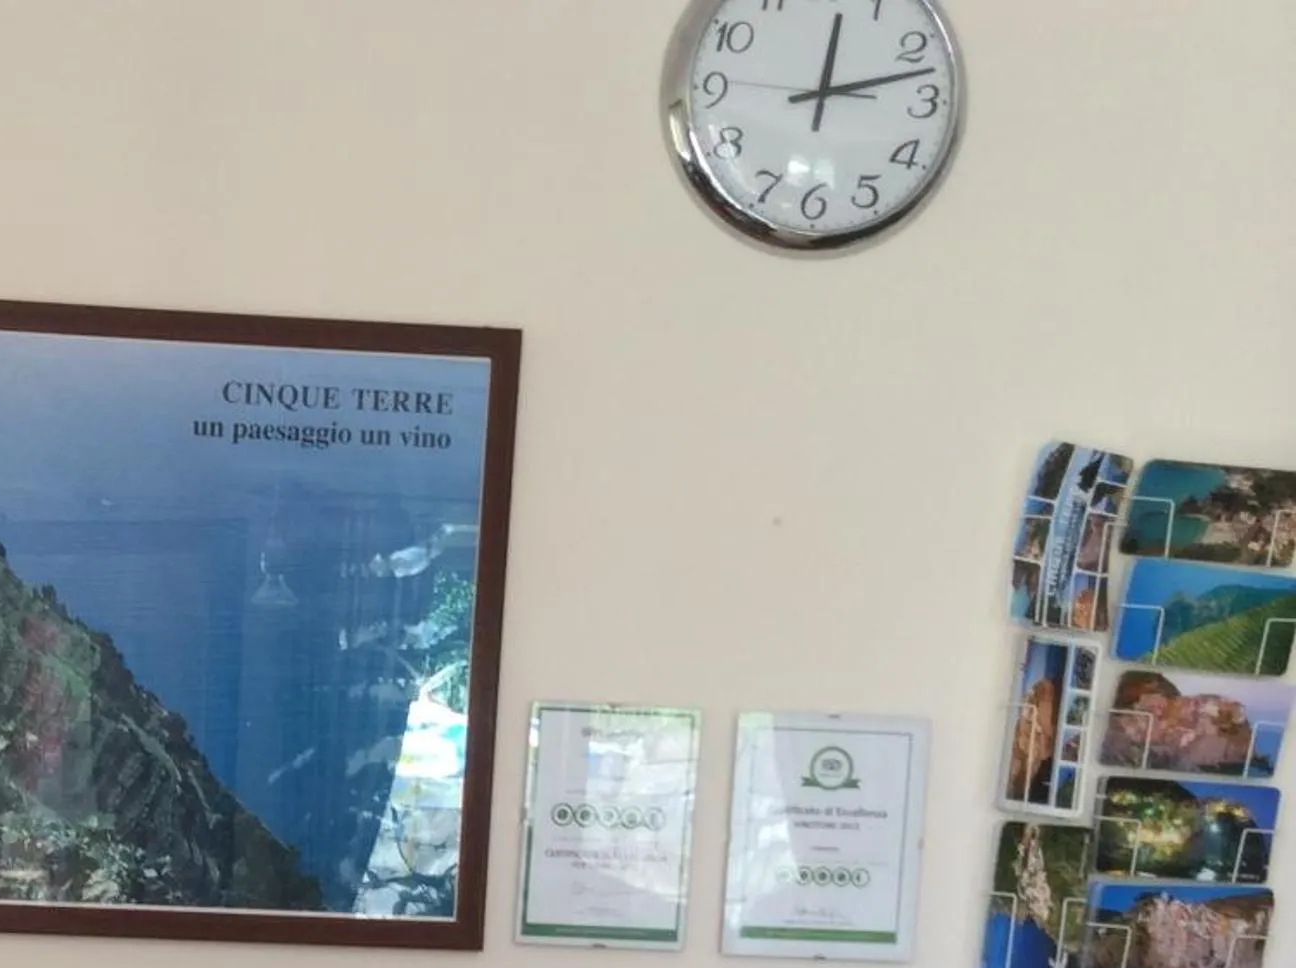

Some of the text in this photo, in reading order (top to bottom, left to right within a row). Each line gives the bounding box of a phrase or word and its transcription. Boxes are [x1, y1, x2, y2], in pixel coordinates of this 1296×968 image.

[716, 21, 754, 53] 10
[896, 30, 928, 63] 2
[703, 71, 728, 108] 9
[907, 84, 939, 119] 3
[713, 126, 743, 159] 8
[889, 139, 920, 169] 4
[754, 169, 783, 203] 7
[801, 182, 828, 220] 6
[851, 175, 882, 209] 5
[222, 380, 454, 415] CINQUE TERRE
[193, 419, 451, 449] un paesaggio un vino
